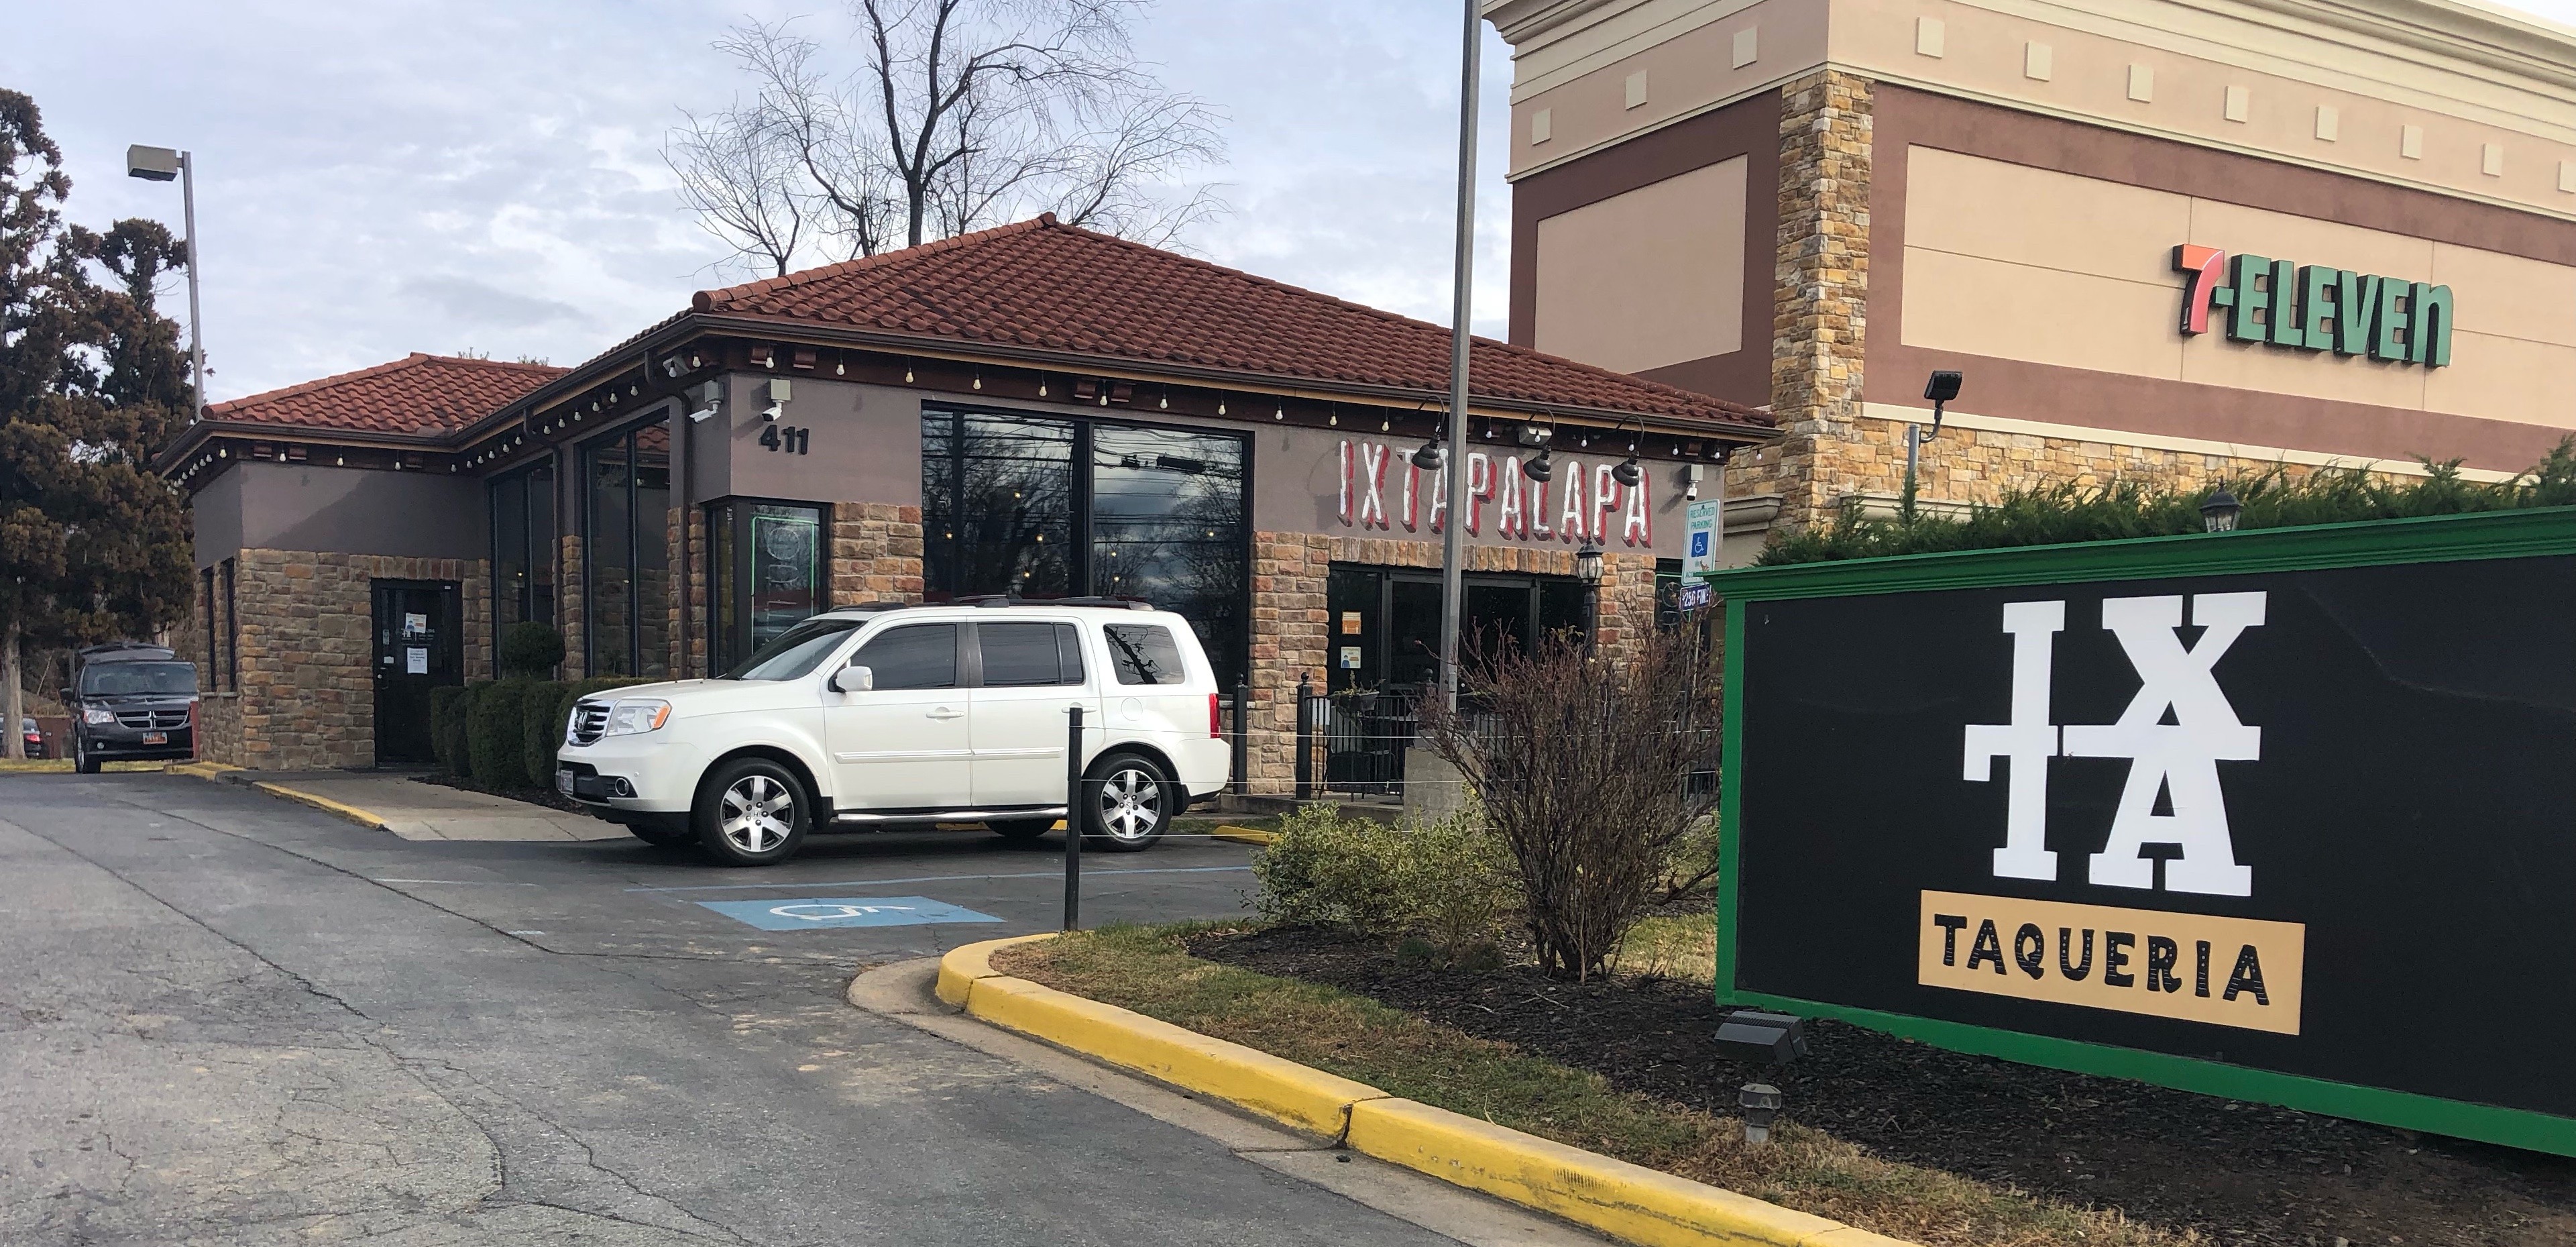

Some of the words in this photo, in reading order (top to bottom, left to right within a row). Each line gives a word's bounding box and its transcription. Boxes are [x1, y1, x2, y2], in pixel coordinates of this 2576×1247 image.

[759, 425, 809, 455] 411
[1690, 507, 1715, 518] RESERVED
[1691, 519, 1713, 529] PARKING
[1934, 914, 2270, 1006] TAQUERIA
